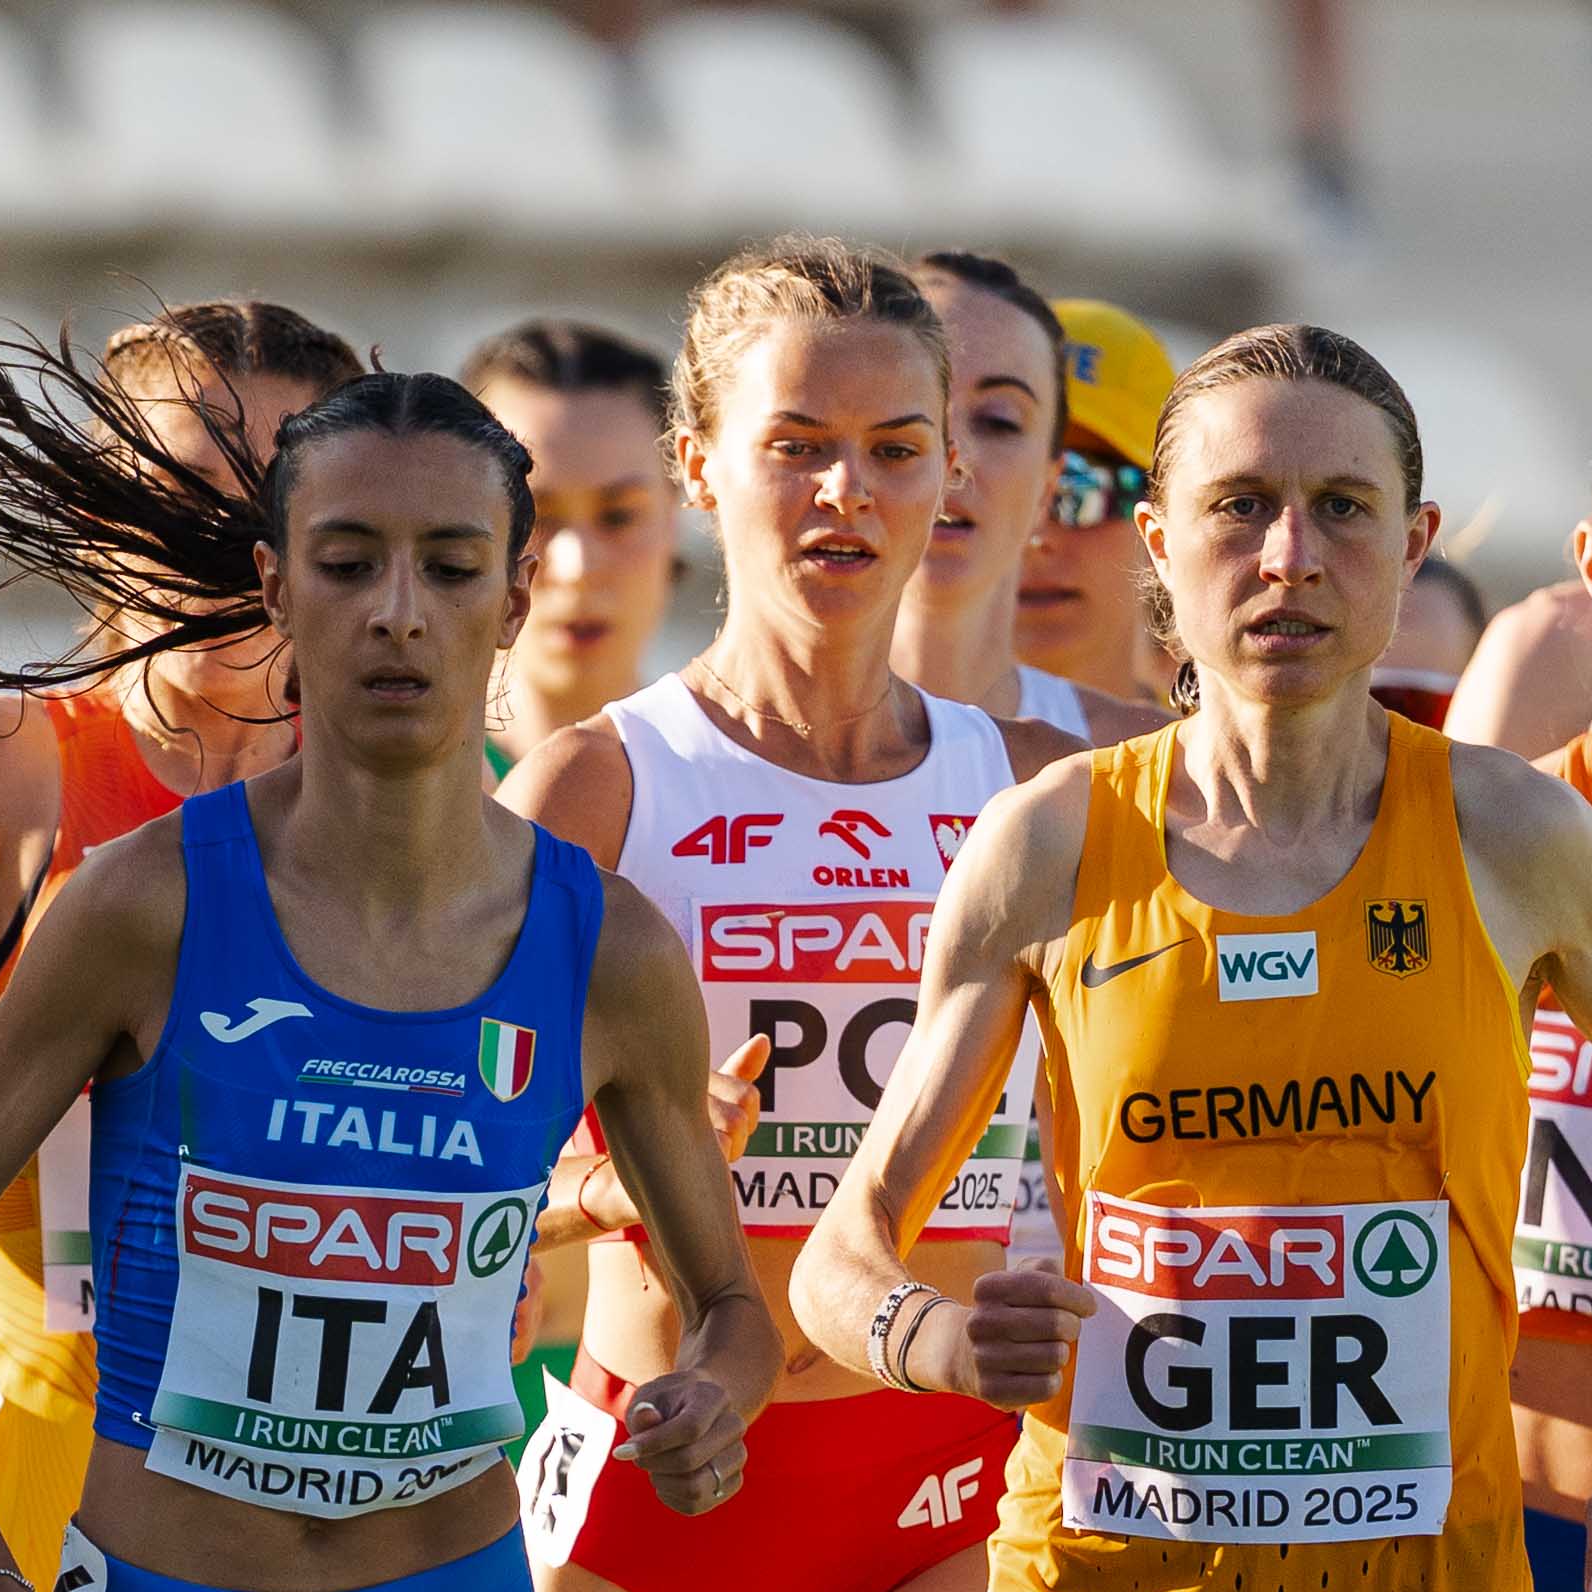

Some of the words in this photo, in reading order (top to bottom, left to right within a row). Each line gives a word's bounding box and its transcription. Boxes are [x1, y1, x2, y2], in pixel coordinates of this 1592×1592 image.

[672, 813, 785, 865] 4F
[812, 865, 910, 888] ORLEN
[1219, 946, 1316, 984] WGV
[301, 1058, 467, 1089] FRECCIAROSSA
[749, 997, 1007, 1114] PO
[266, 1098, 484, 1167] ITALIA
[1120, 1070, 1438, 1144] GERMANY
[775, 1126, 783, 1153] I
[191, 1190, 454, 1273] SPAR
[1096, 1215, 1338, 1288] SPAR
[1543, 1243, 1553, 1272] I
[246, 1286, 452, 1415] ITA
[1124, 1312, 1404, 1432] GER
[234, 1411, 245, 1438] I
[251, 1415, 329, 1450] RUN
[1144, 1437, 1152, 1464] I
[1158, 1439, 1229, 1471] RUN
[183, 1439, 384, 1506] MADRID
[896, 1456, 985, 1529] 4F
[1092, 1476, 1290, 1528] MADRID
[1302, 1482, 1419, 1528] 2025
